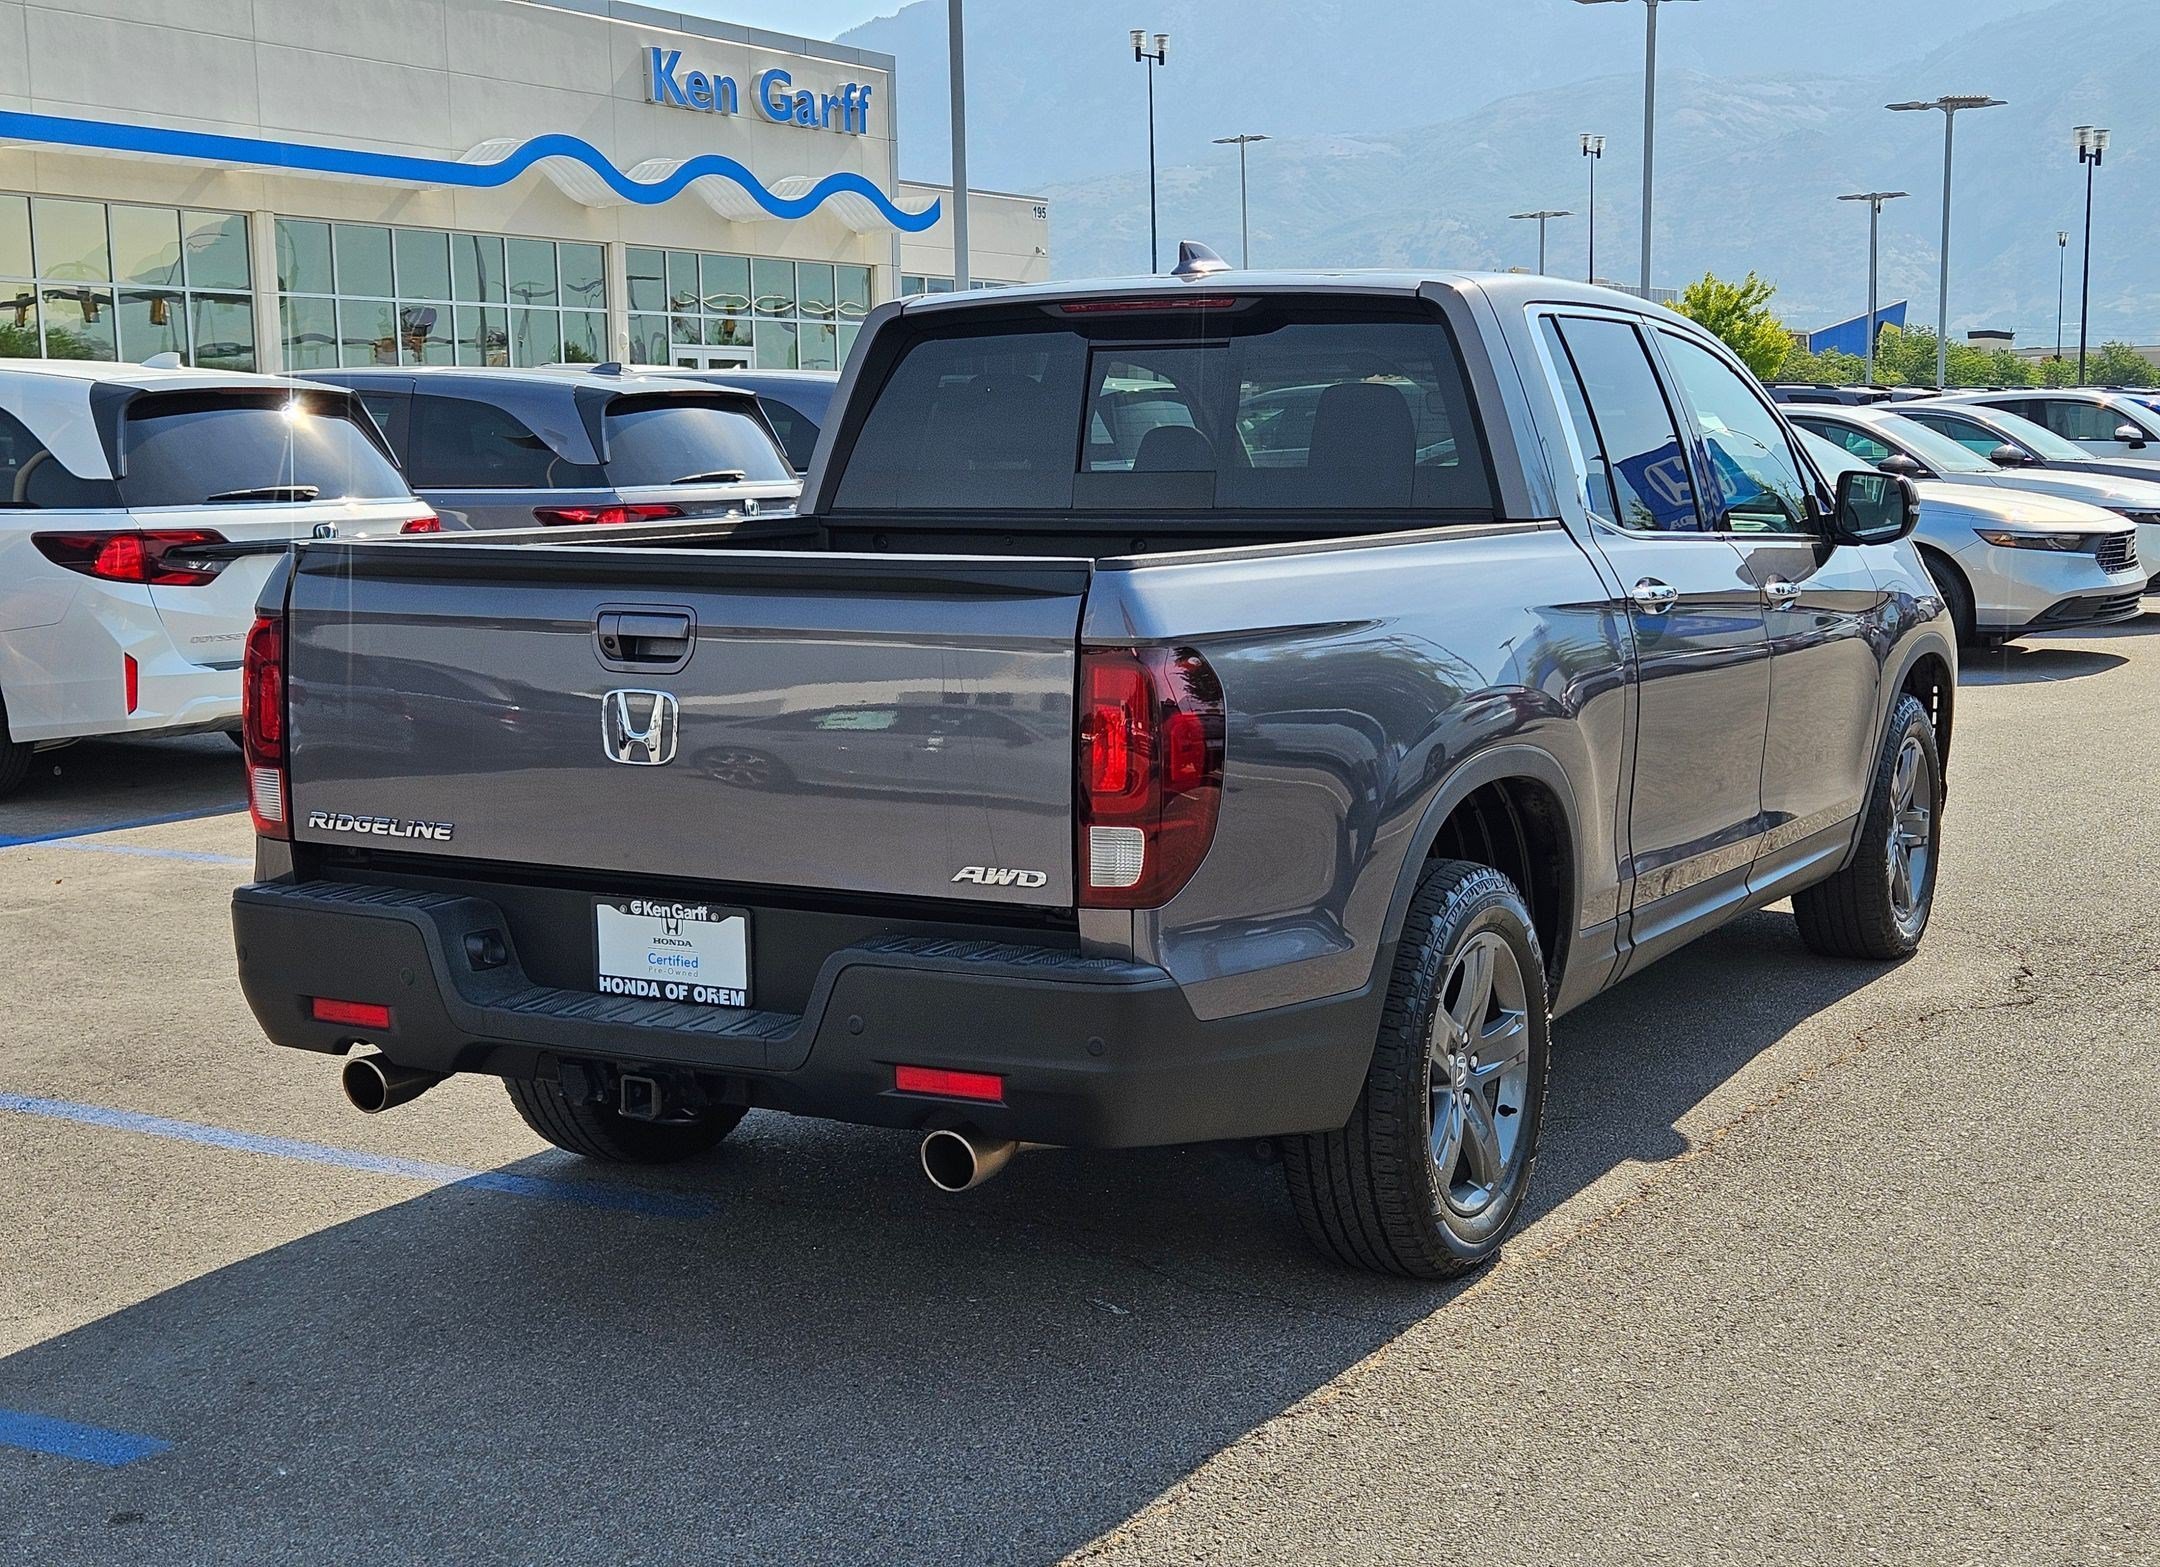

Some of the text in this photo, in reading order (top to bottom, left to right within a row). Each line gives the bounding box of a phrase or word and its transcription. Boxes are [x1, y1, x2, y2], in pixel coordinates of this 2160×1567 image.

[647, 46, 873, 135] Ken Garff
[1032, 205, 1047, 219] 195
[308, 810, 454, 841] RIDGELINE
[950, 865, 1048, 888] AWD
[643, 901, 708, 920] Ken Garff
[652, 937, 693, 948] HONDA
[647, 952, 699, 969] Certified
[648, 967, 699, 978] Pre-Owned
[599, 976, 746, 1007] HONDA OF OREM
